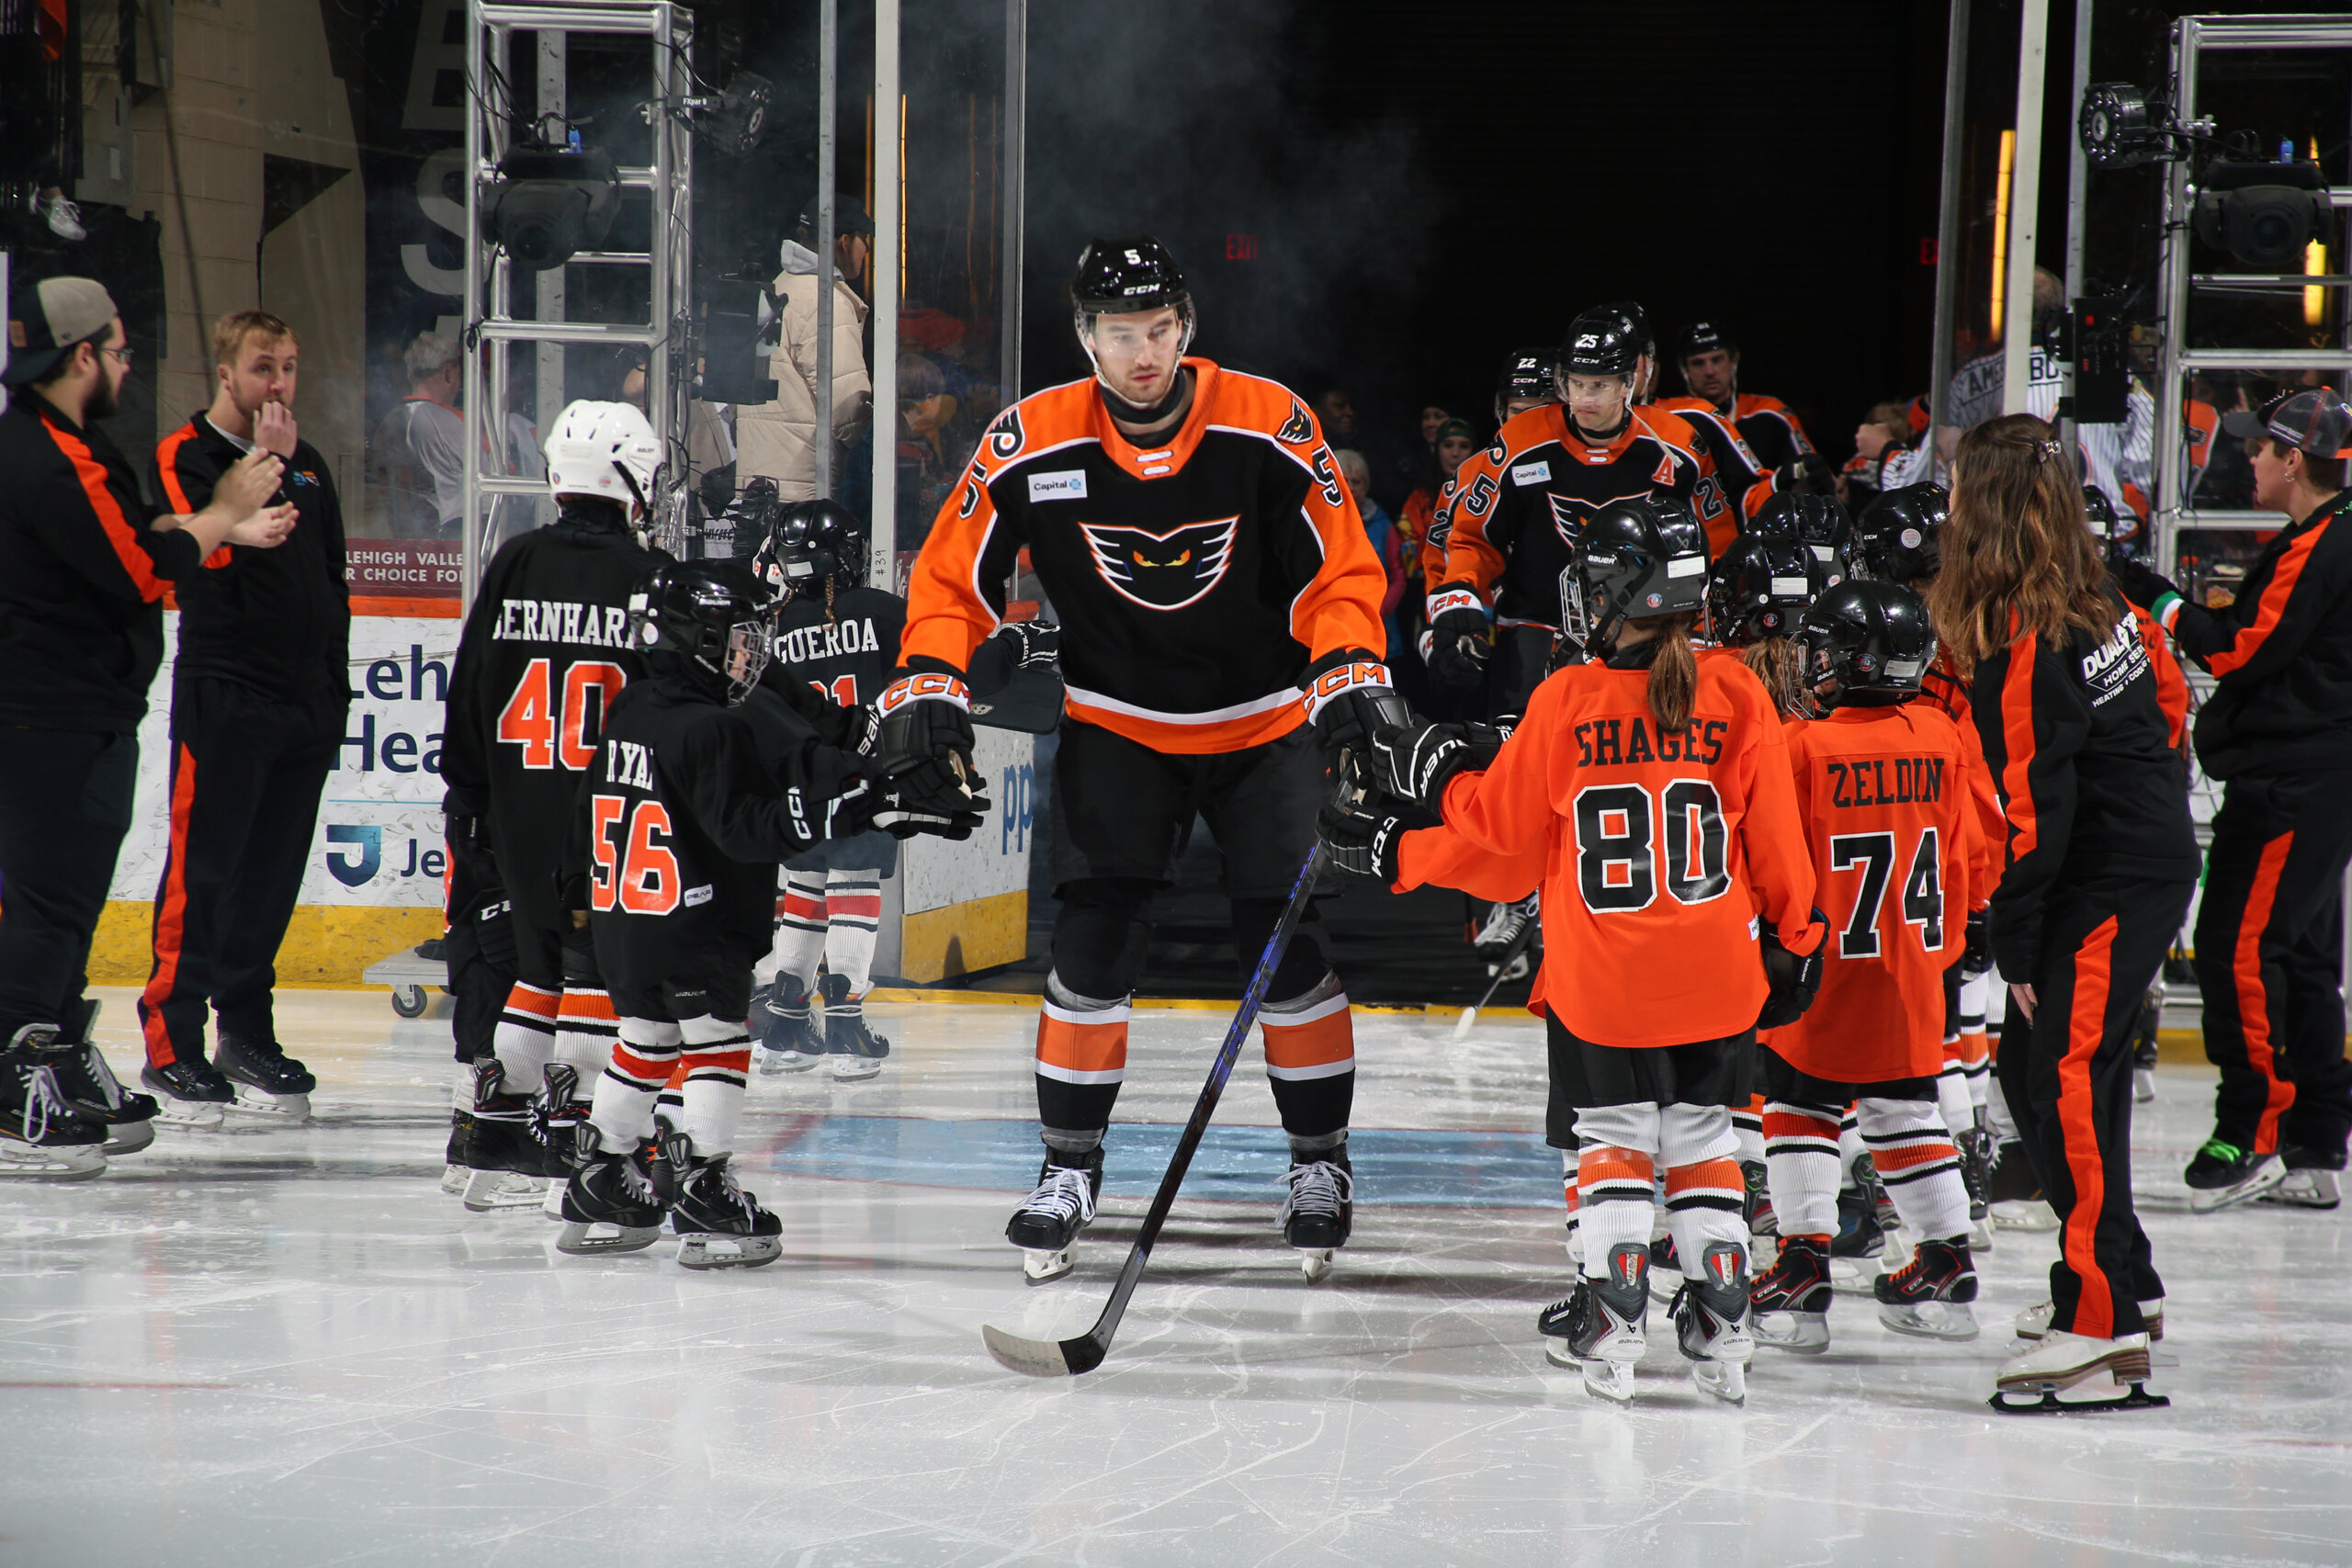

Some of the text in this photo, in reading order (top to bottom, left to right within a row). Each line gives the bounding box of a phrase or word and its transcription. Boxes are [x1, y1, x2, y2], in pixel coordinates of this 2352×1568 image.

[1124, 249, 1141, 265] 5
[1226, 233, 1259, 260] EXIT
[1123, 283, 1160, 296] CCM
[1575, 333, 1599, 349] 25
[1517, 357, 1537, 369] 22
[1573, 356, 1600, 365] CCM
[1311, 446, 1343, 507] 5
[1651, 454, 1677, 487] A
[1033, 479, 1069, 493] Capital
[345, 551, 406, 565] LEHIGH
[1588, 555, 1617, 566] BAUER
[364, 568, 427, 582] CHOICE
[436, 569, 463, 583] FO
[1807, 625, 1830, 635] BAUER
[2103, 660, 2130, 687] HOME
[2092, 683, 2125, 708] HEATING
[496, 658, 627, 771] 40
[1574, 716, 1728, 767] SHAGES
[1827, 758, 1944, 807] ZELDIN
[590, 794, 682, 916] 56
[1371, 816, 1399, 878] CCM
[1572, 778, 1734, 914] 80
[1829, 826, 1944, 959] 74
[1757, 1283, 1777, 1299] CCM
